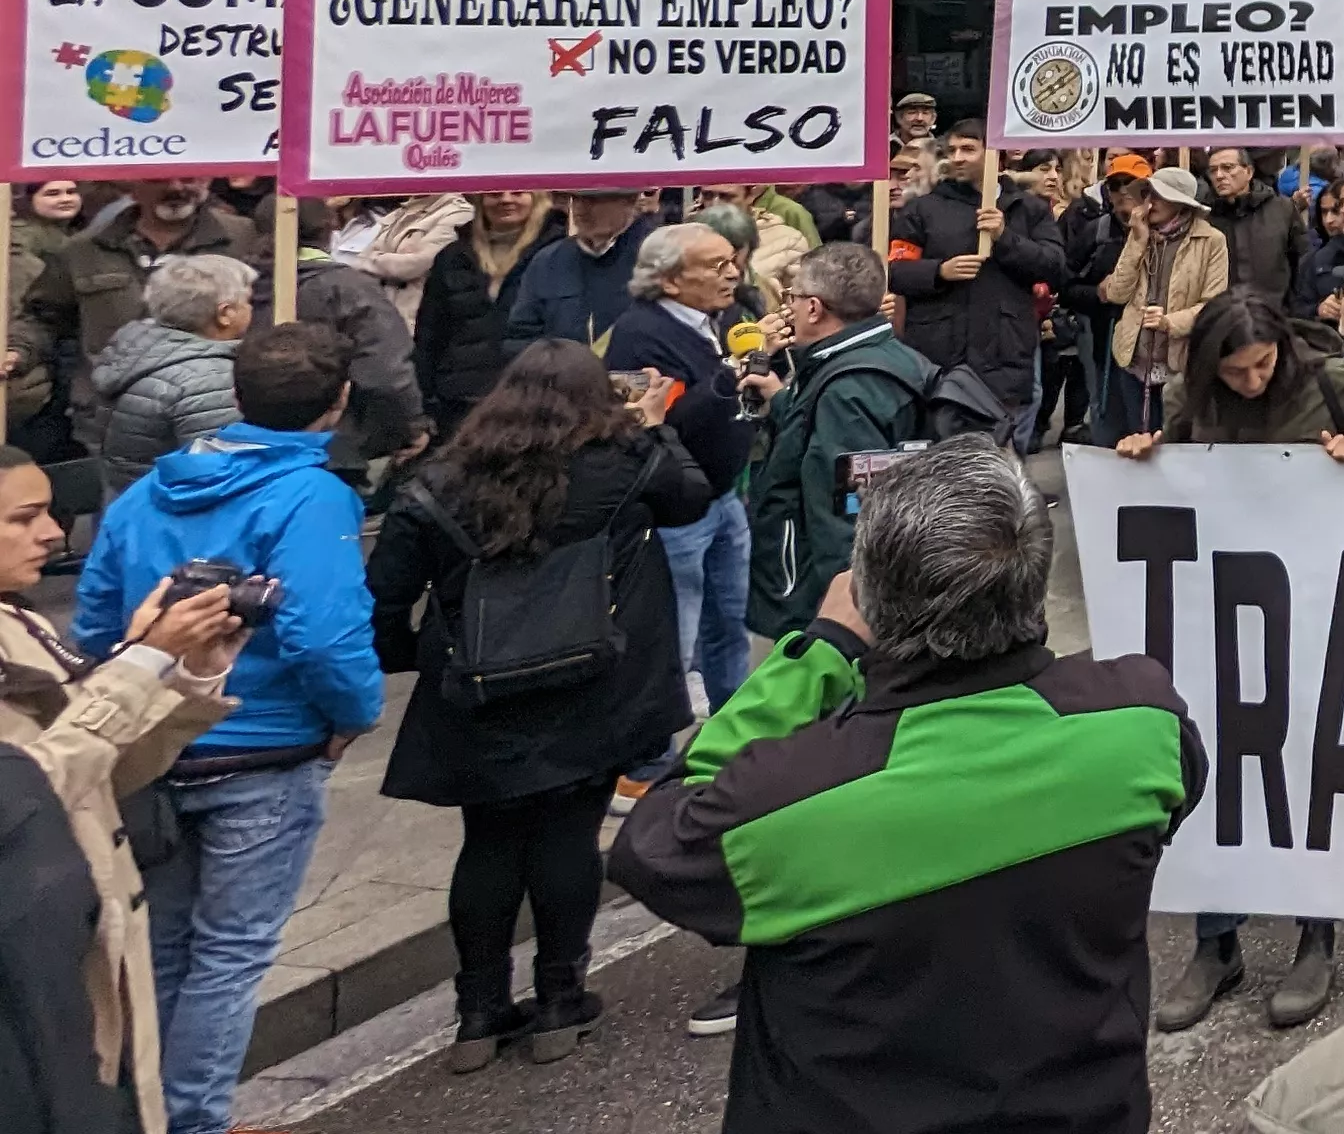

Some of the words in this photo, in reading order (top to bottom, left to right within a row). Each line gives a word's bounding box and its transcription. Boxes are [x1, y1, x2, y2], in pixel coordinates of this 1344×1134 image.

[1044, 1, 1315, 37] EMPLEO?
[608, 38, 658, 75] NO
[667, 38, 706, 75] ES
[714, 38, 847, 75] VERDAD
[1105, 42, 1146, 88] NO
[1166, 41, 1201, 90] ES
[1220, 40, 1335, 89] VERDAD
[346, 74, 433, 105] Asociación
[436, 73, 454, 105] de
[458, 74, 520, 109] Mujeres
[332, 110, 382, 144] LA
[389, 109, 530, 143] FUENTE
[1104, 93, 1336, 132] MIENTEN
[31, 127, 187, 159] cedace
[589, 104, 843, 161] FALSO
